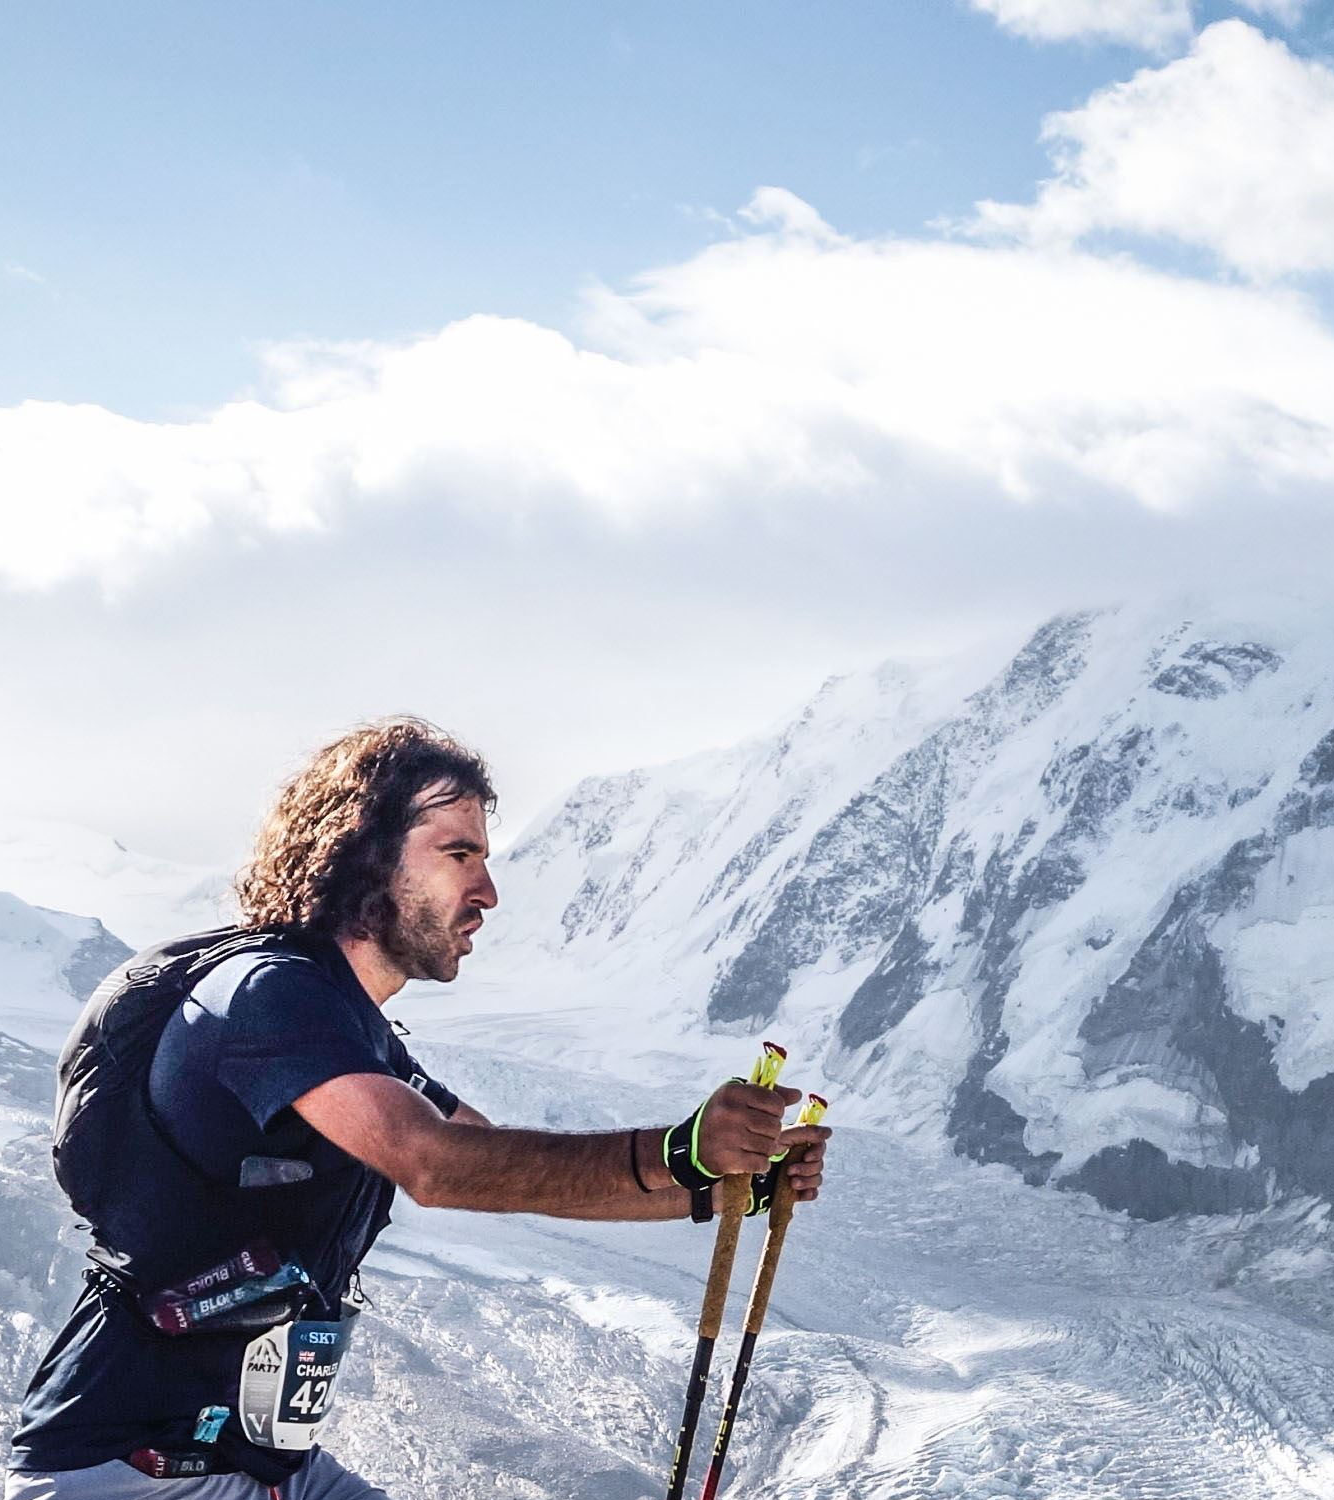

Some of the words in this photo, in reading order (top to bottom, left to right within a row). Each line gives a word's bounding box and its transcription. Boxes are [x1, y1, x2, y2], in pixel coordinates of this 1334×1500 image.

[187, 1267, 230, 1296] BLOKS
[246, 1362, 281, 1374] PARTY
[247, 1413, 268, 1434] V
